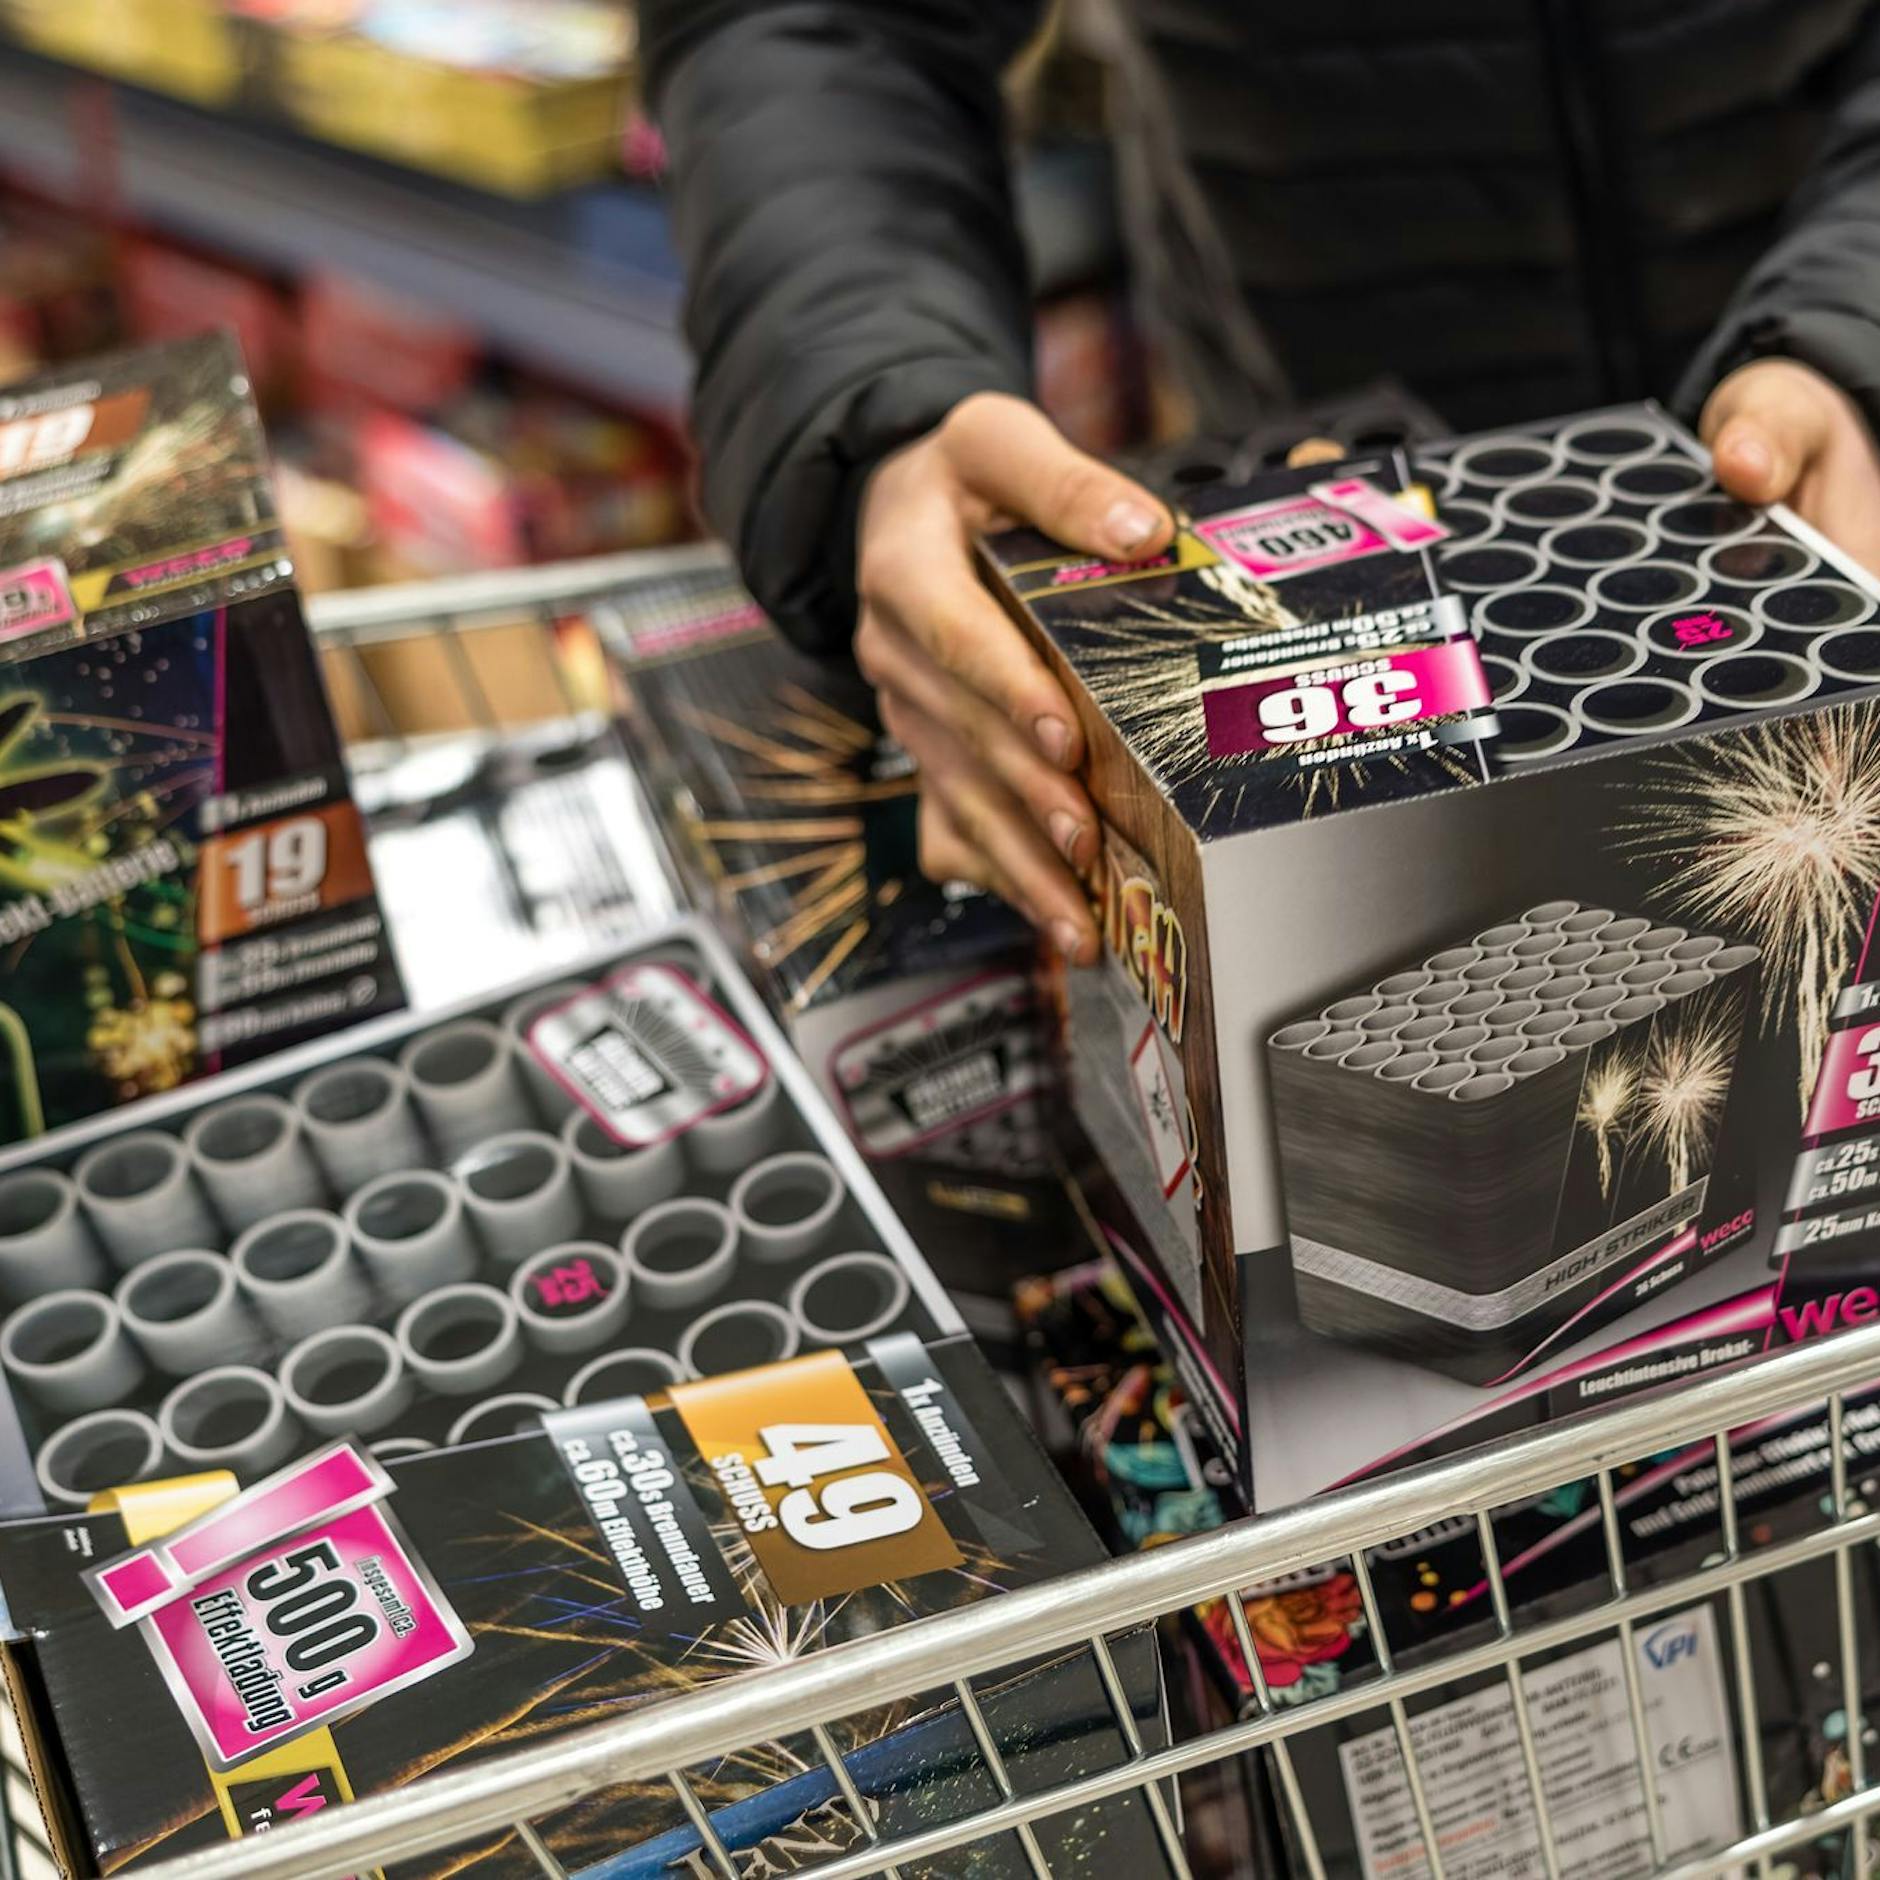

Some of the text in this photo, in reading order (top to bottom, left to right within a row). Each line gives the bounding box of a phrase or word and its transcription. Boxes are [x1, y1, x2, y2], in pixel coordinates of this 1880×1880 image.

[1258, 521, 1353, 557] 460
[1220, 637, 1342, 671] Brenndauer
[1294, 658, 1392, 688] SCHUSS
[1257, 670, 1423, 744] 36
[1298, 736, 1403, 767] Anzünden
[225, 817, 328, 909] 19
[1544, 1250, 1598, 1291] HIGH
[1604, 1195, 1696, 1258] STRIKER
[1700, 1208, 1755, 1250] weco
[1578, 1338, 1755, 1397] Leuchtintensive Brokat-
[752, 1423, 924, 1551] 49
[913, 1405, 980, 1488] Anzünden
[709, 1452, 780, 1534] SCHUSS
[600, 1516, 665, 1612] Effekthöhe
[643, 1500, 717, 1603] Brenndauer
[246, 1538, 379, 1673] 500
[193, 1588, 295, 1734] Effektladung
[299, 1667, 349, 1699] g
